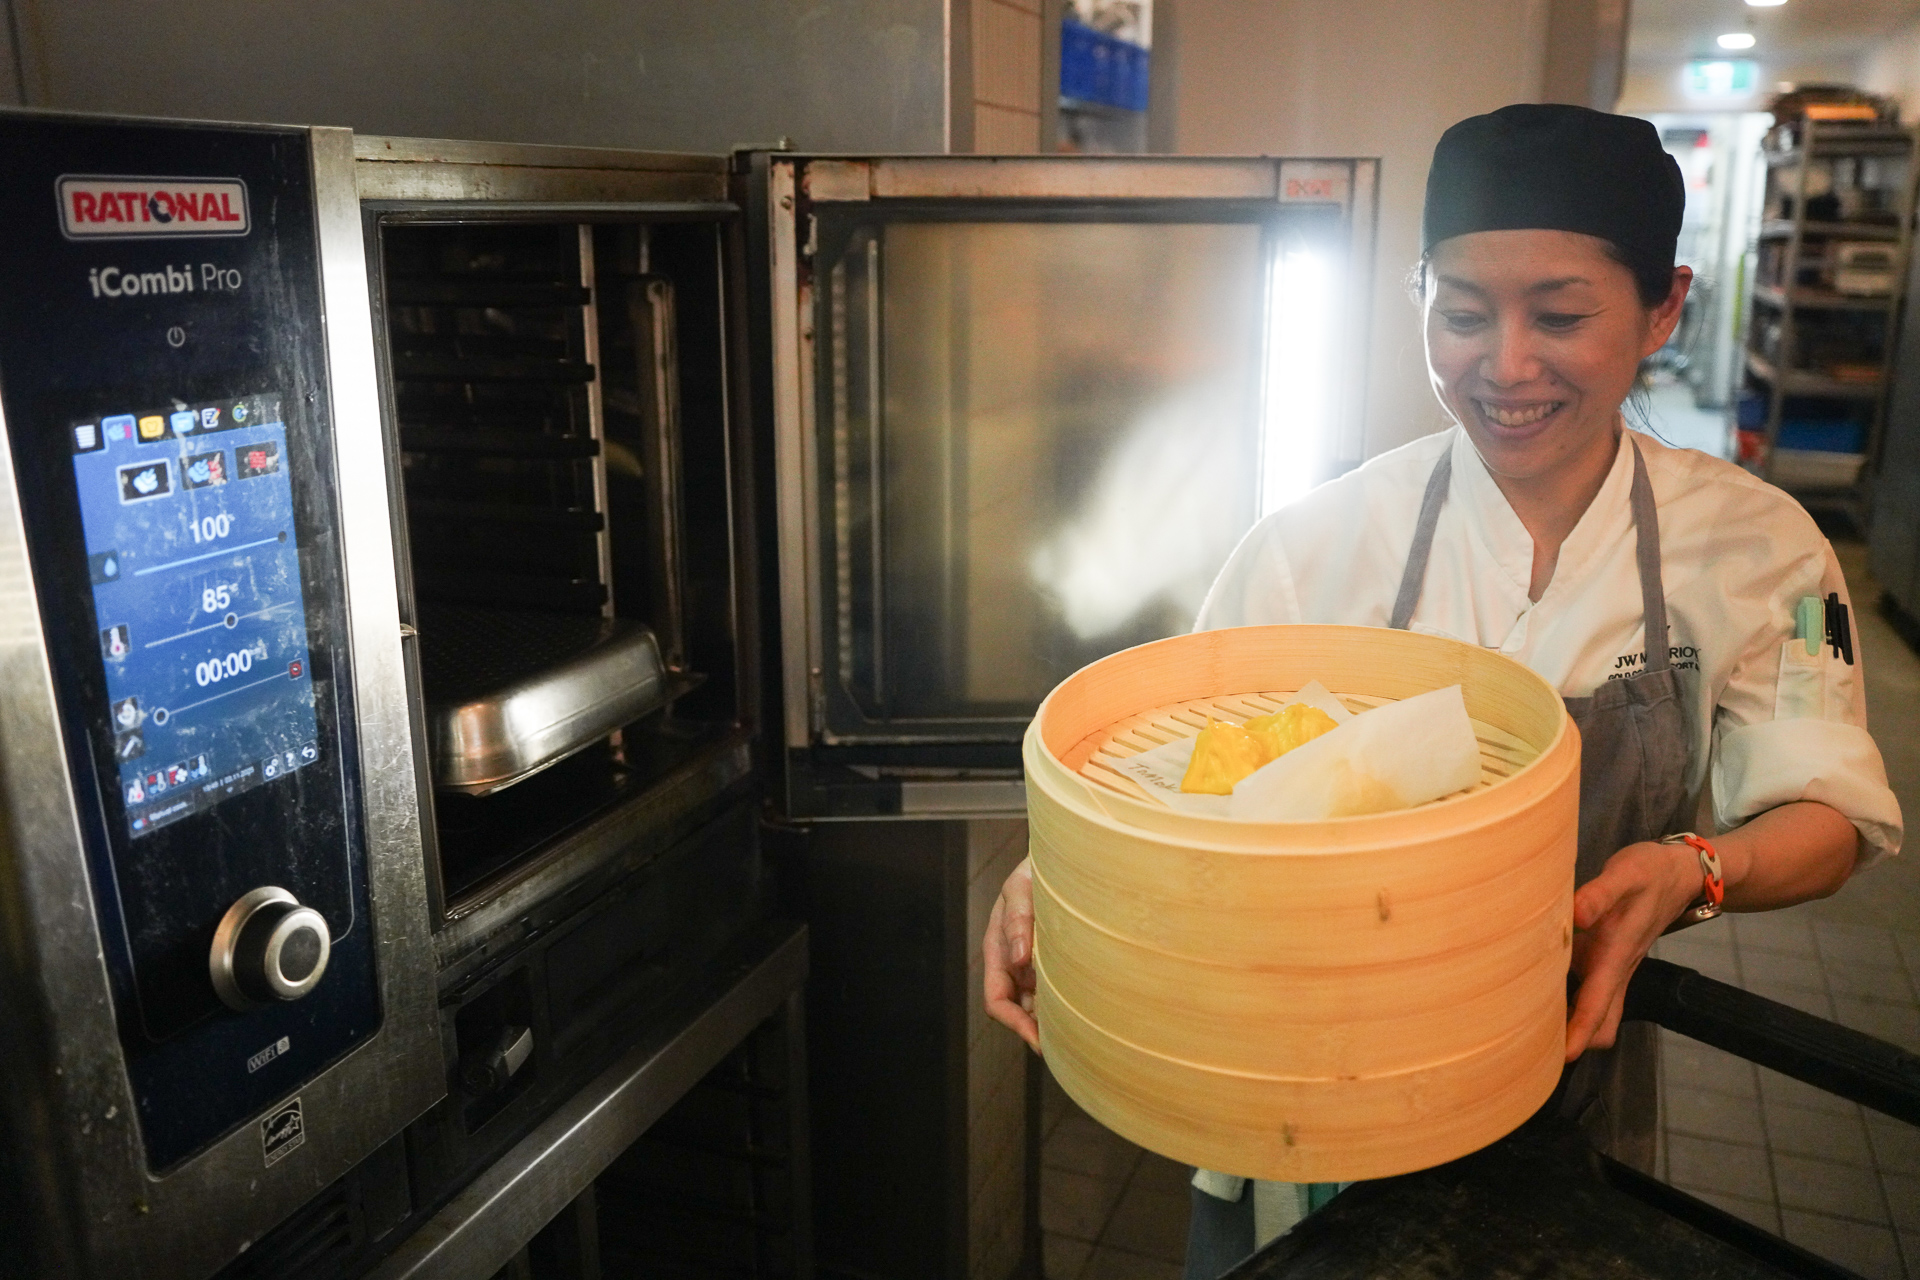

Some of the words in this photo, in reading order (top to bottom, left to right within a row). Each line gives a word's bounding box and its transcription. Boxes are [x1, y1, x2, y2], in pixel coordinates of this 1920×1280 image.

[72, 190, 240, 223] RATIONAL
[88, 265, 194, 298] iCombi
[201, 263, 242, 290] Pro
[195, 649, 252, 687] 00:00
[1615, 654, 1638, 669] JW
